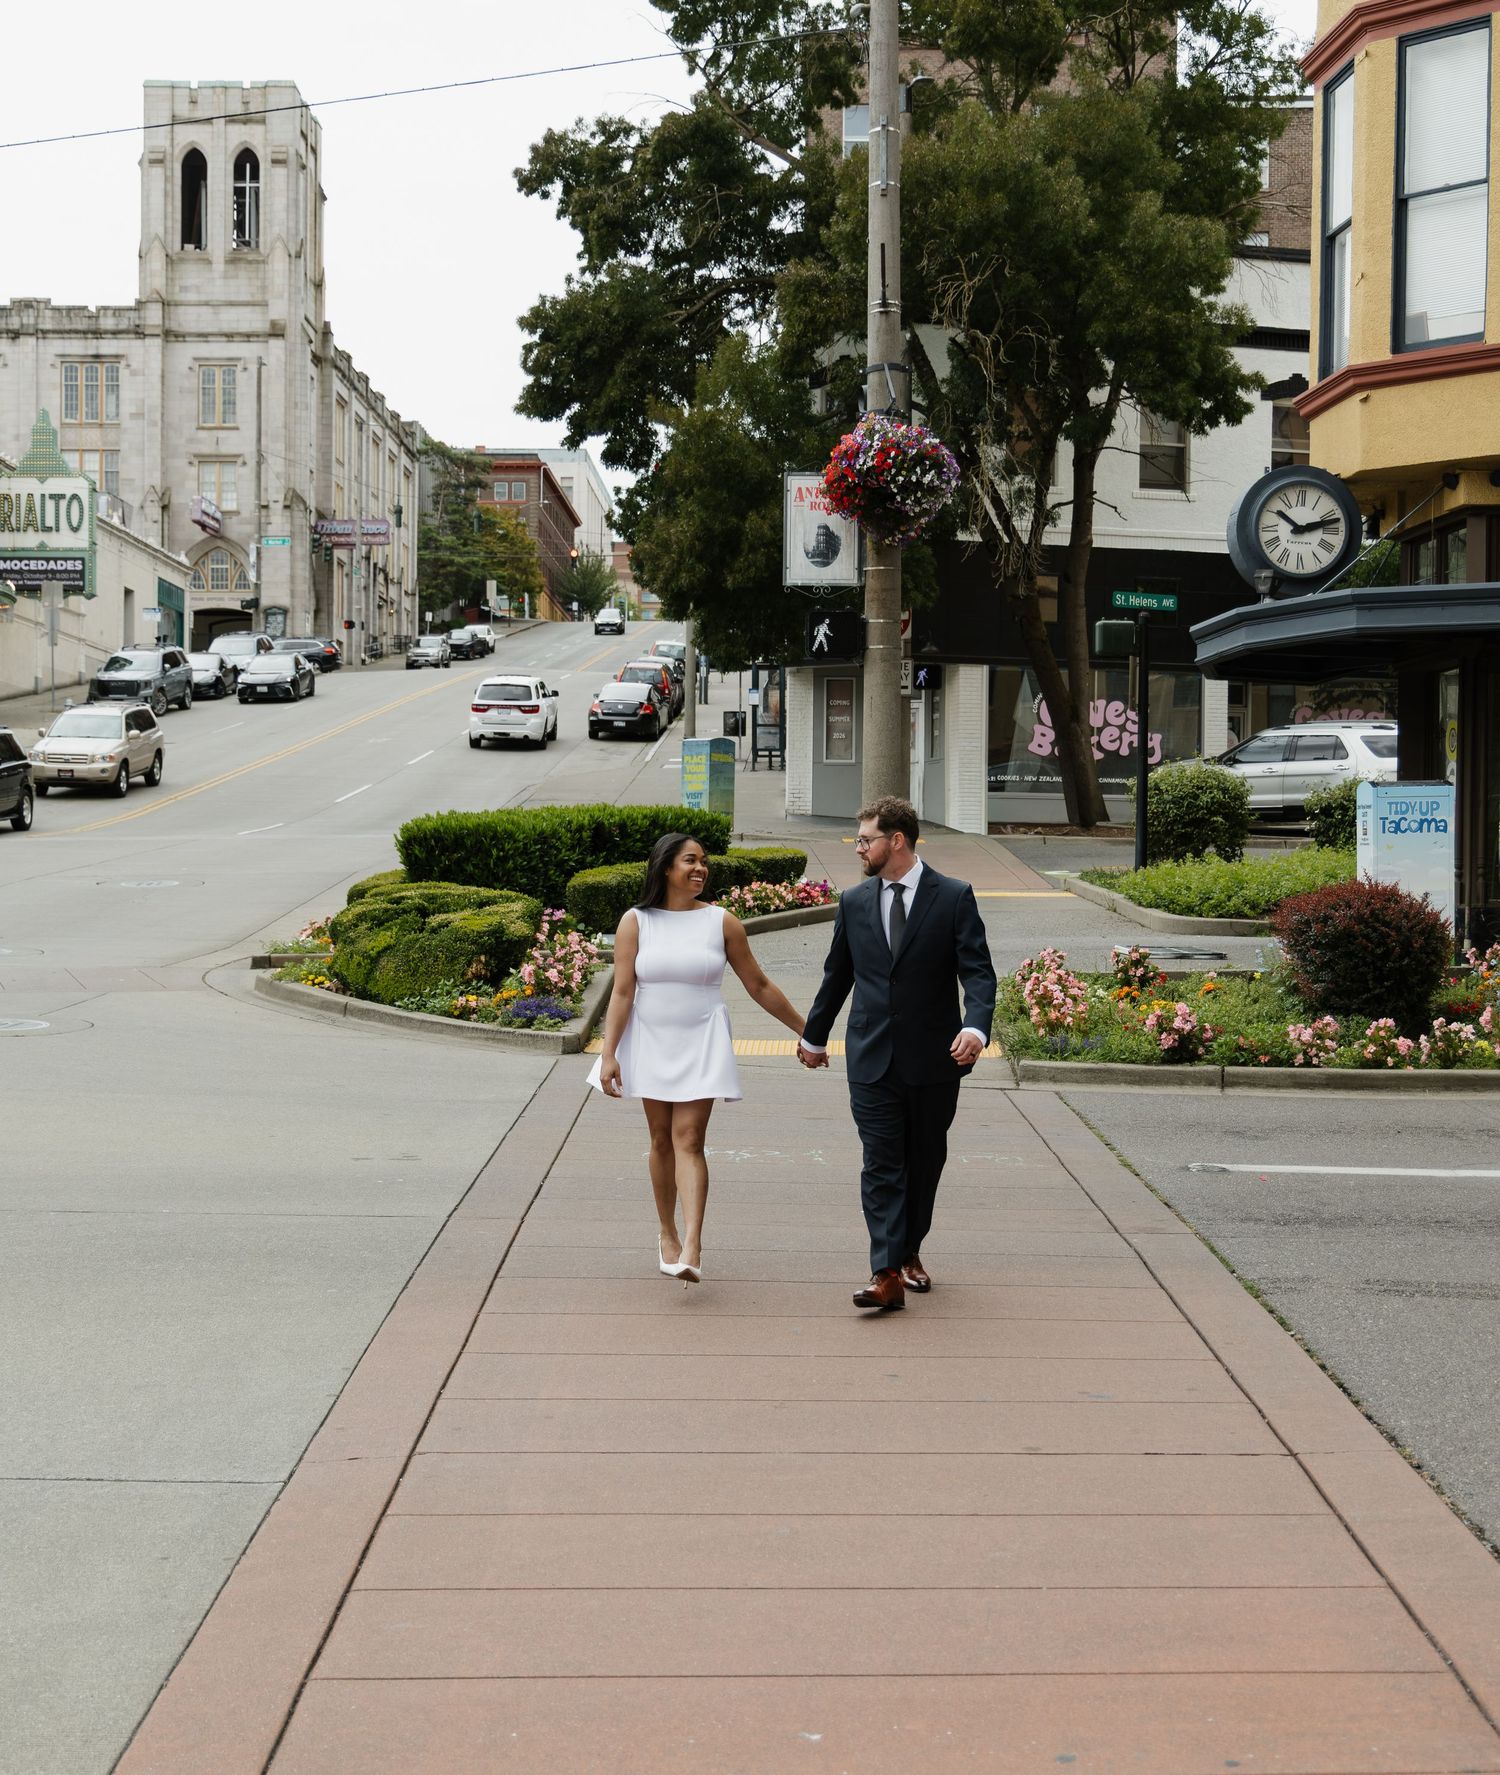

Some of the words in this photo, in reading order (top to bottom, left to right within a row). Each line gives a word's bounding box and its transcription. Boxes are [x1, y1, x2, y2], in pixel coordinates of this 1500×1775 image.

[810, 502, 829, 511] RO
[0, 493, 84, 533] RIALTO
[0, 560, 83, 571] MOCEDADES
[1115, 594, 1127, 605] St.
[1129, 595, 1158, 608] Helens
[1162, 599, 1175, 608] AVE
[686, 792, 703, 800] VISIT
